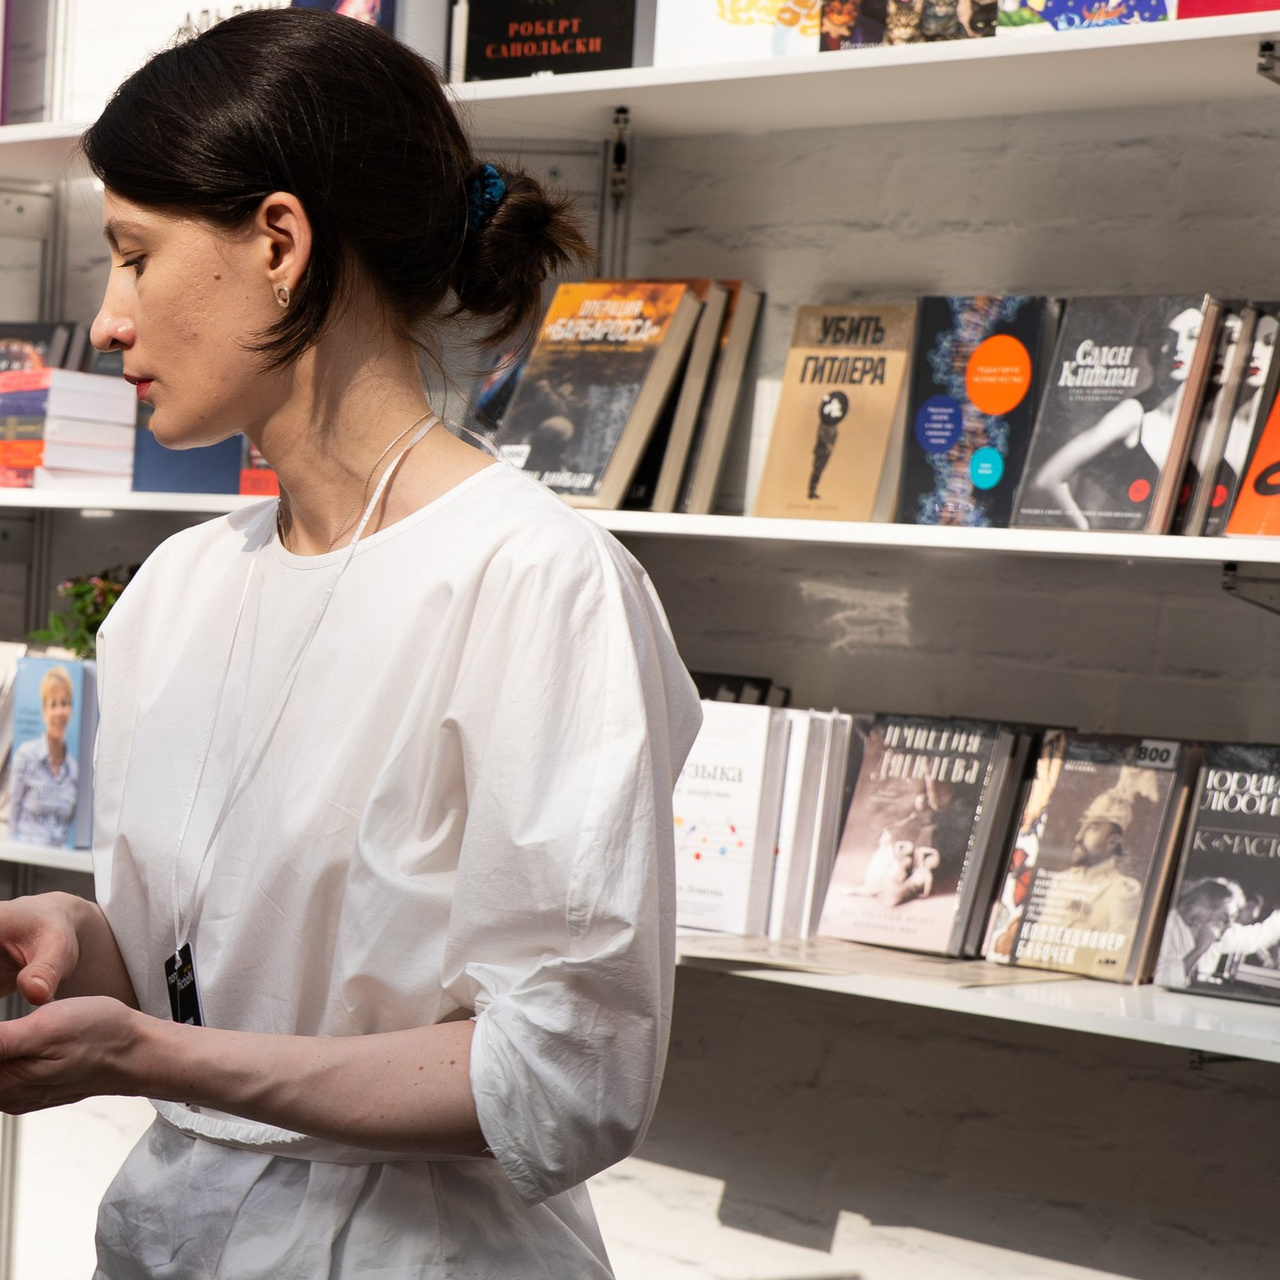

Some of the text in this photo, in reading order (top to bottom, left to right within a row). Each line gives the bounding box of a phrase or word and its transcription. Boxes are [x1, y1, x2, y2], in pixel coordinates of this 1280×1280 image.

[508, 18, 582, 39] РОБЕРТ
[485, 37, 603, 60] САПОЛЬСКИ
[817, 315, 886, 345] УБИТЬ
[799, 355, 887, 387] ГИТЛЕРА
[1057, 360, 1139, 388] Китти
[1137, 747, 1171, 764] 800
